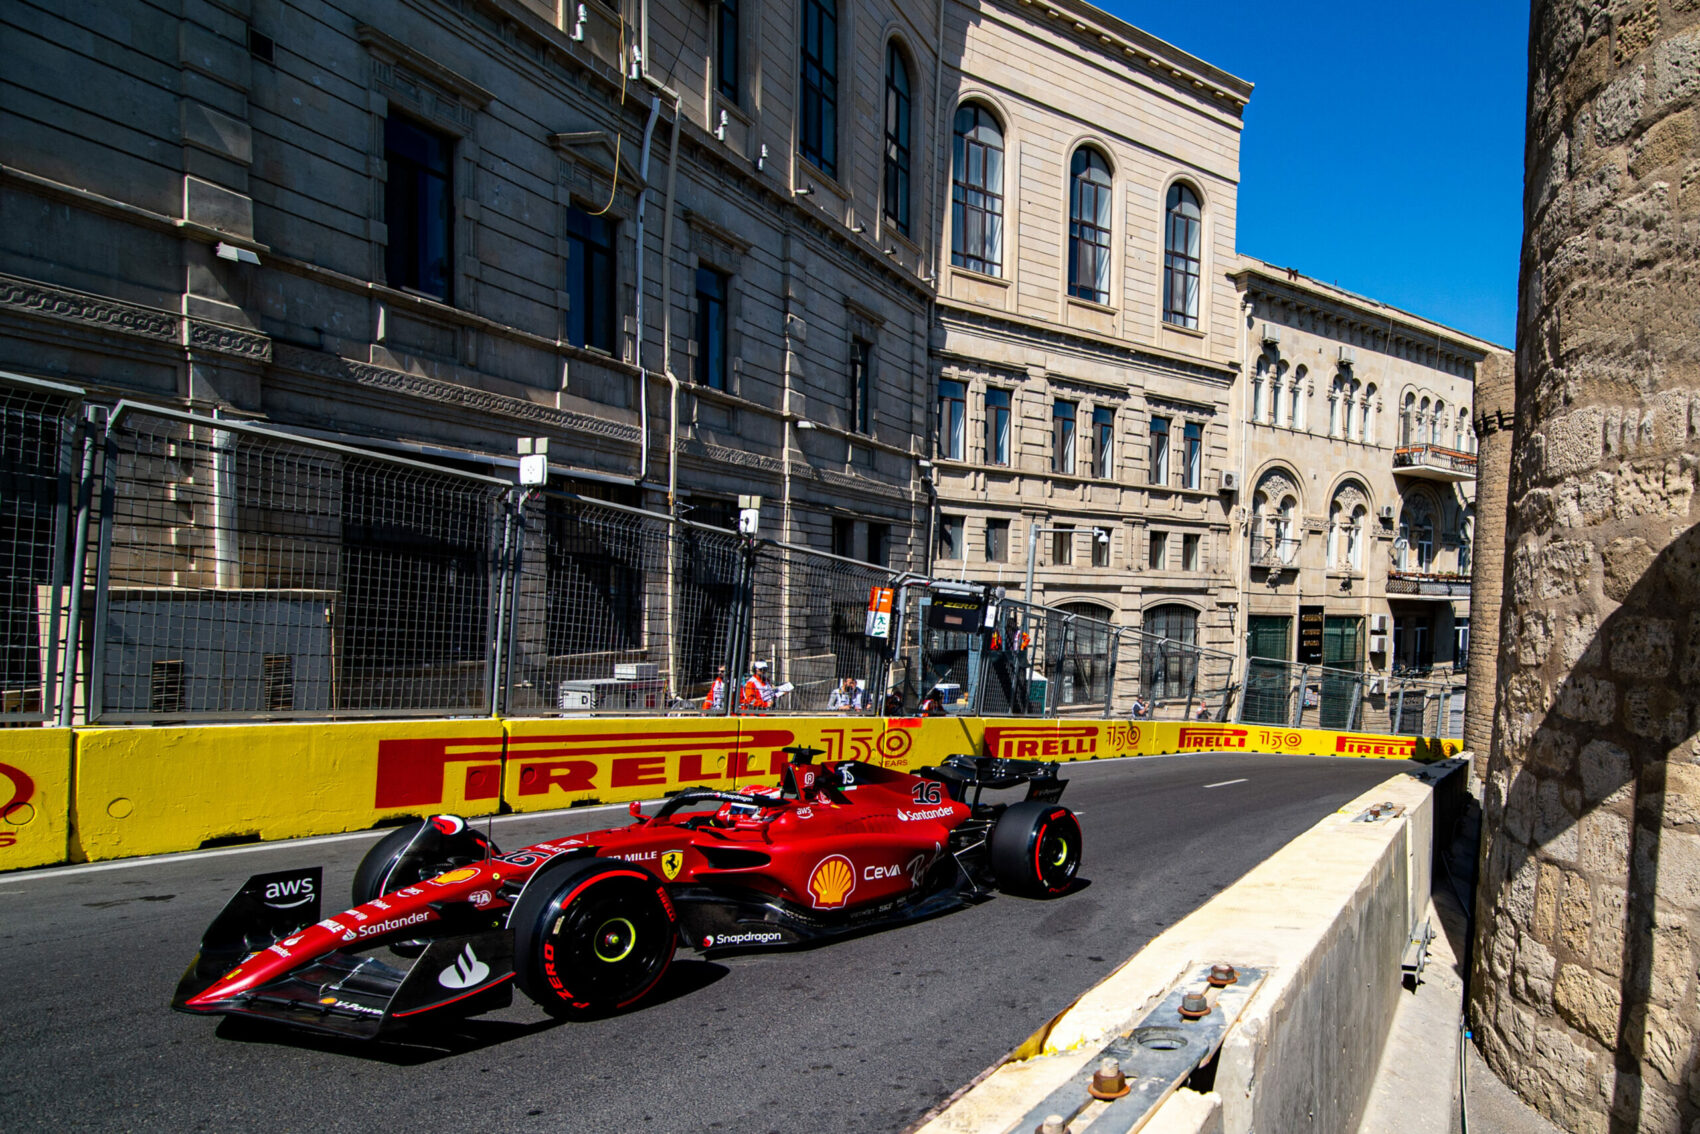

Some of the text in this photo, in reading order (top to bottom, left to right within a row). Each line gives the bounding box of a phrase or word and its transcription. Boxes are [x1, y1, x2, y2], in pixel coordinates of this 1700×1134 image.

[876, 589, 891, 610] F
[943, 602, 979, 610] ZERO
[820, 728, 912, 768] 150 YEARS
[984, 726, 1099, 758] PIRELLI
[1106, 725, 1141, 751] 150
[1178, 727, 1248, 748] PIRELLI
[1258, 730, 1302, 750] 150
[1335, 735, 1418, 756] PIRELLI
[374, 729, 795, 810] PIRELLI
[912, 782, 942, 805] 16
[796, 806, 812, 815] aws
[907, 806, 954, 821] Santander
[624, 850, 658, 862] MILLE
[265, 877, 314, 899] aws
[358, 912, 430, 938] Santander
[716, 931, 782, 945] Snapdragon
[544, 943, 575, 1000] ZERO
